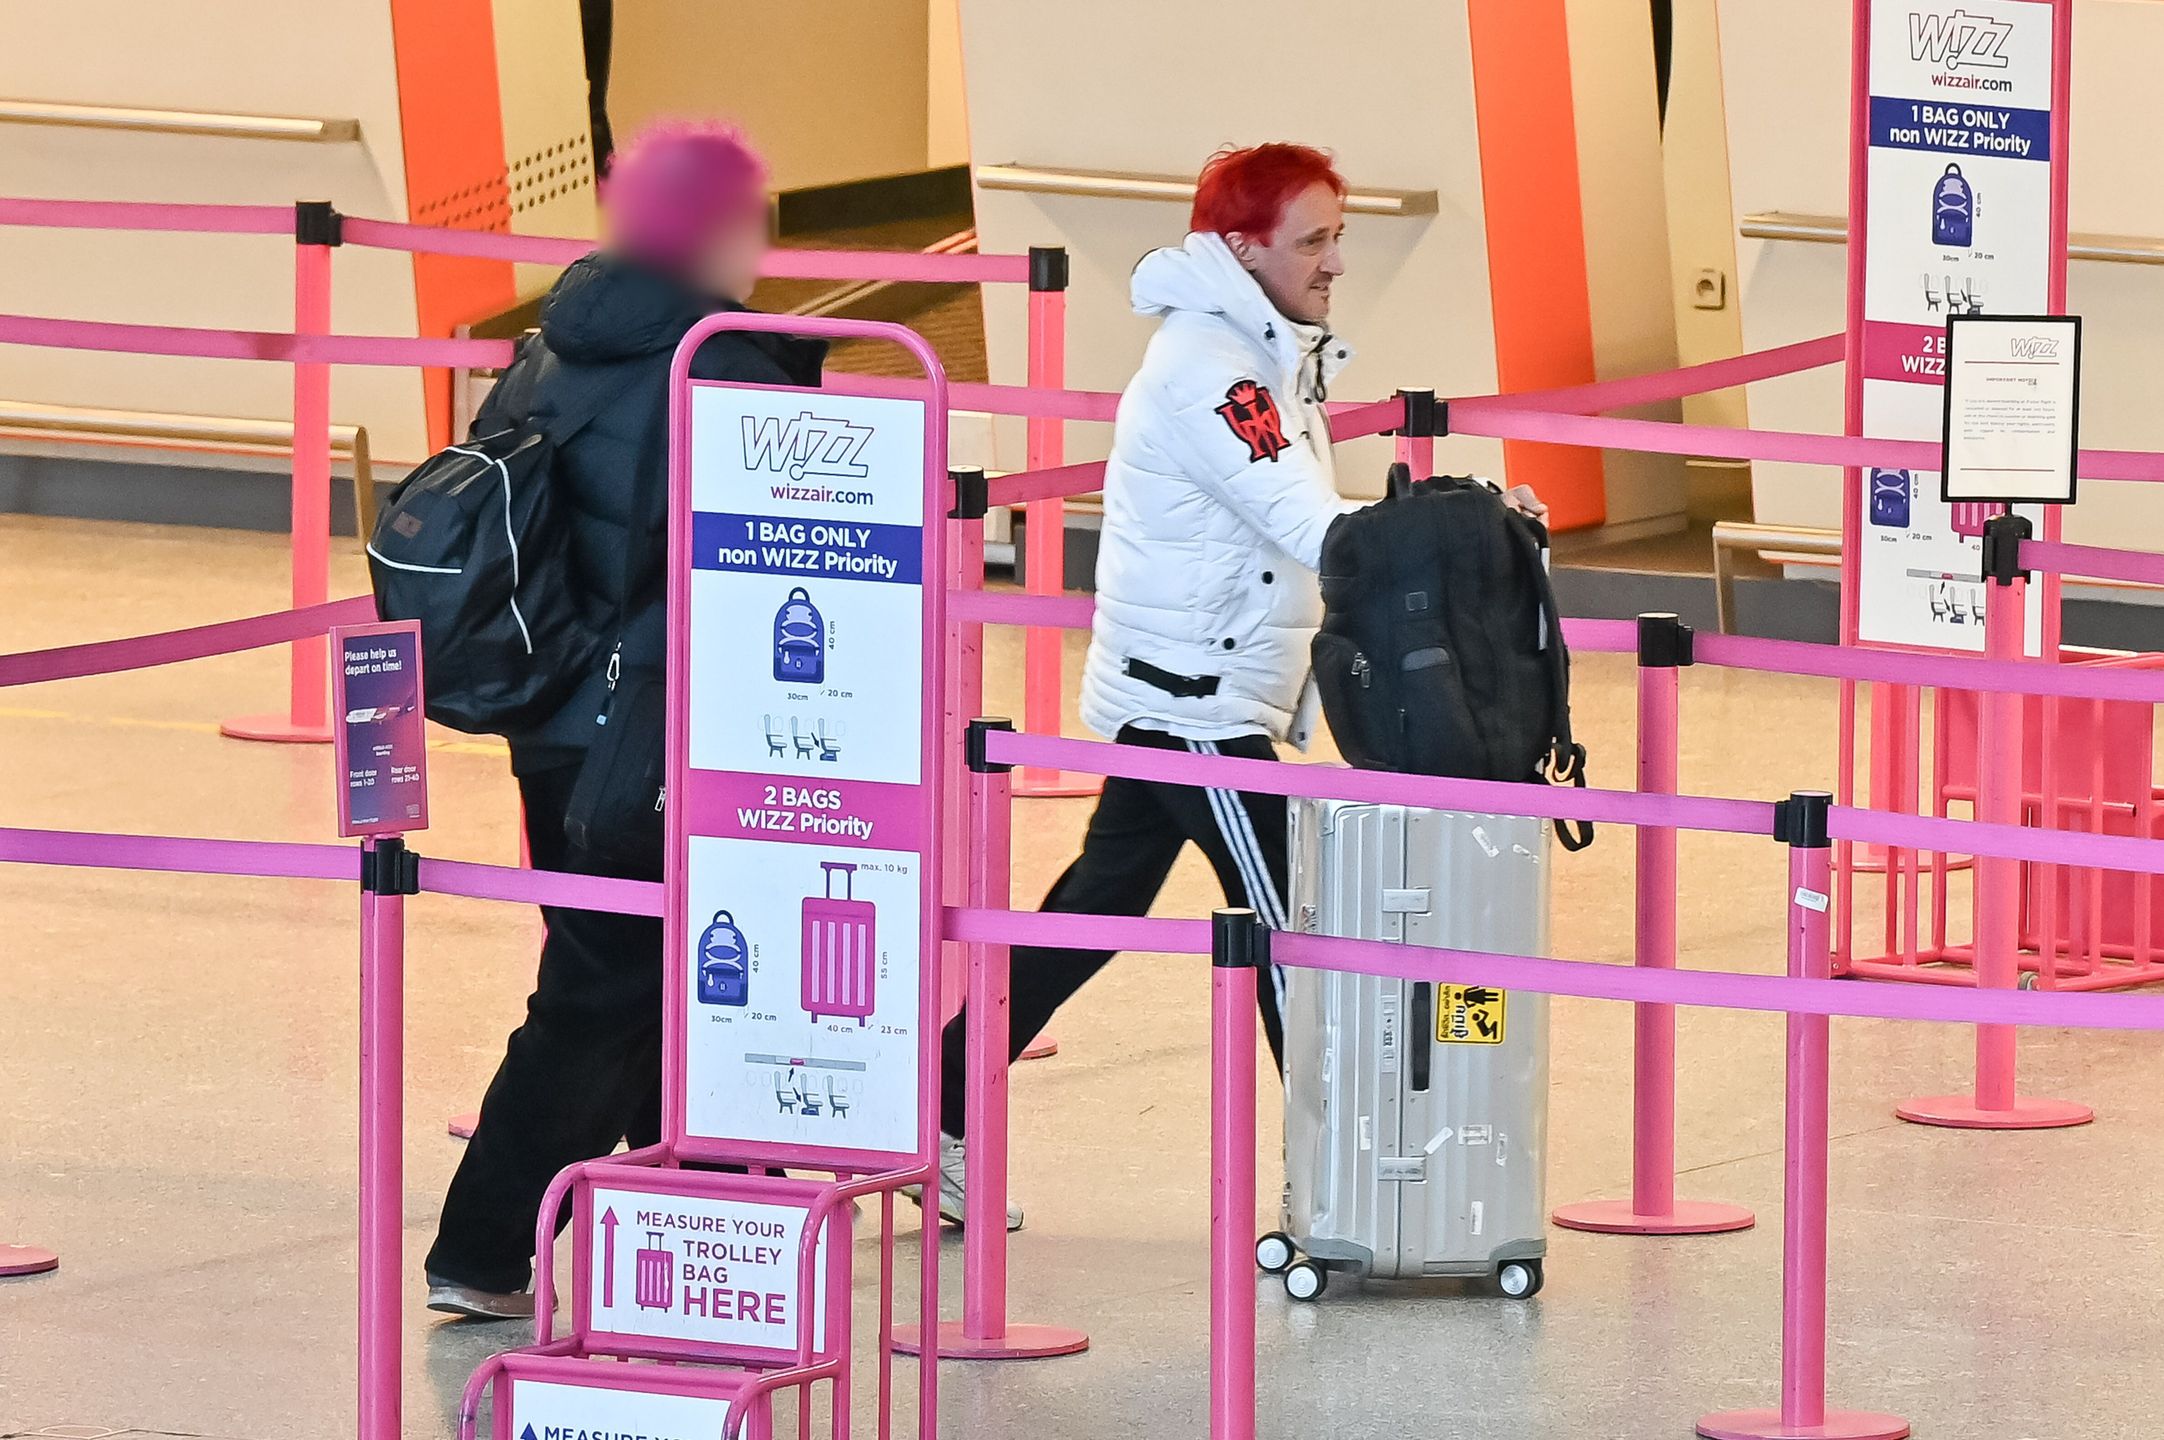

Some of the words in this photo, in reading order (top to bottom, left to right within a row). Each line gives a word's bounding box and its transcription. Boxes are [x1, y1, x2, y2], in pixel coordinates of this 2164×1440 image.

[1931, 72, 2012, 92] wizzair.com
[1911, 105, 1918, 122] 1
[1922, 106, 1959, 125] BAG
[1962, 110, 2010, 130] ONLY
[1890, 127, 1920, 144] non
[1924, 127, 1970, 148] WIZZ
[1973, 131, 2031, 156] Priority
[1922, 335, 1933, 353] 2
[1901, 354, 1945, 375] WIZZ
[770, 483, 874, 505] wizzair.com
[745, 521, 753, 540] 1
[760, 522, 805, 544] BAG
[811, 525, 871, 548] ONLY
[719, 547, 756, 565] non
[762, 547, 819, 570] WIZZ
[825, 551, 898, 578] Priority
[829, 620, 835, 634] cm
[828, 636, 835, 650] 40
[344, 650, 369, 662] Please
[370, 648, 387, 660] help
[388, 649, 397, 658] us
[345, 663, 370, 677] depart
[371, 664, 381, 673] on
[382, 660, 402, 671] time!
[827, 689, 838, 697] 20
[764, 785, 777, 806] 2
[782, 787, 842, 810] BAGS
[737, 808, 795, 831] WIZZ
[800, 813, 874, 840] Priority
[861, 863, 882, 872] max.
[884, 864, 895, 873] 10
[897, 864, 908, 875] kg
[753, 944, 759, 958] cm
[882, 951, 888, 965] cm
[753, 961, 759, 973] 40
[881, 967, 888, 979] 55
[751, 1012, 763, 1020] 20
[827, 1024, 839, 1032] 40
[841, 1025, 853, 1033] cm
[880, 1026, 892, 1034] 23
[894, 1027, 908, 1035] cm
[636, 1210, 726, 1233] MEASURE
[732, 1219, 785, 1239] YOUR
[682, 1240, 782, 1266] TROLLEY
[682, 1264, 728, 1284] BAG
[683, 1285, 786, 1325] HERE
[544, 1426, 647, 1440] MEAS
